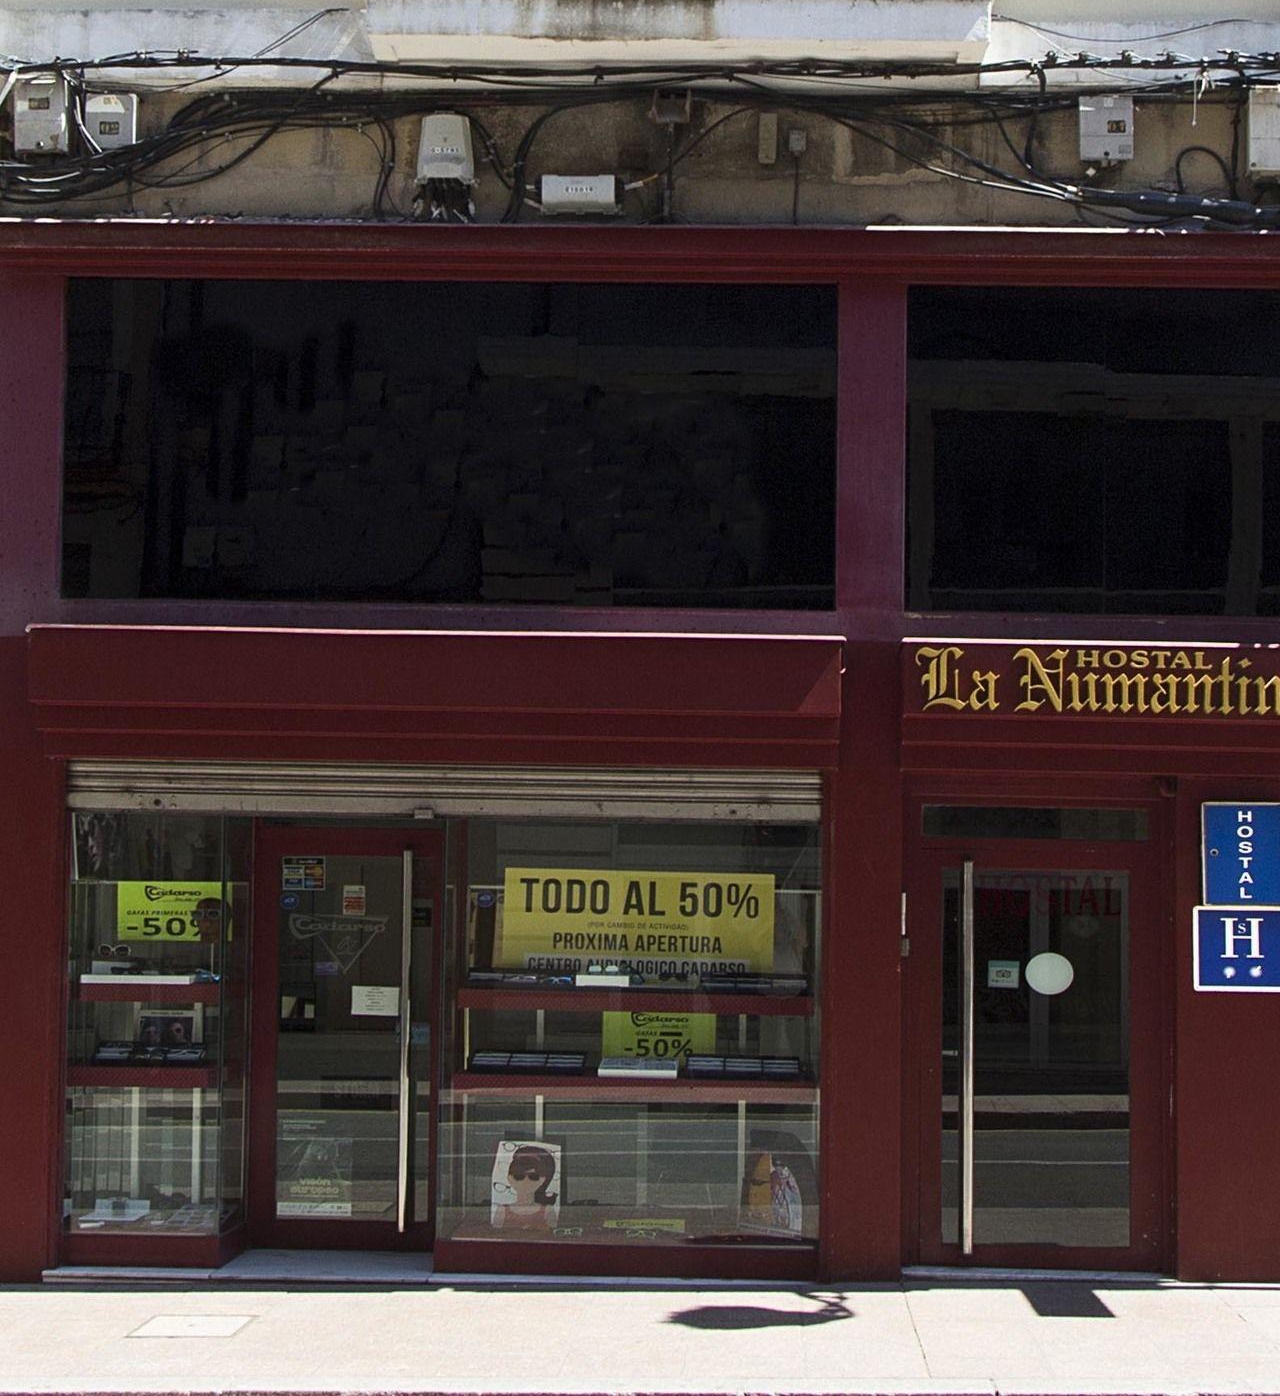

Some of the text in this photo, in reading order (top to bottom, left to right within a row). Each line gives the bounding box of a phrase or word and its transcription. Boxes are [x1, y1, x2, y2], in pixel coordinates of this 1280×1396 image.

[1076, 650, 1213, 670] HOSTAL
[915, 646, 1001, 712] La
[1236, 810, 1254, 899] HOSTAL
[147, 887, 202, 898] Cadarso
[520, 877, 759, 919] TODO AL 50%
[553, 932, 722, 953] PROXIMA APERTURA
[528, 957, 582, 973] CENTRO
[624, 1038, 694, 1058] -50%
